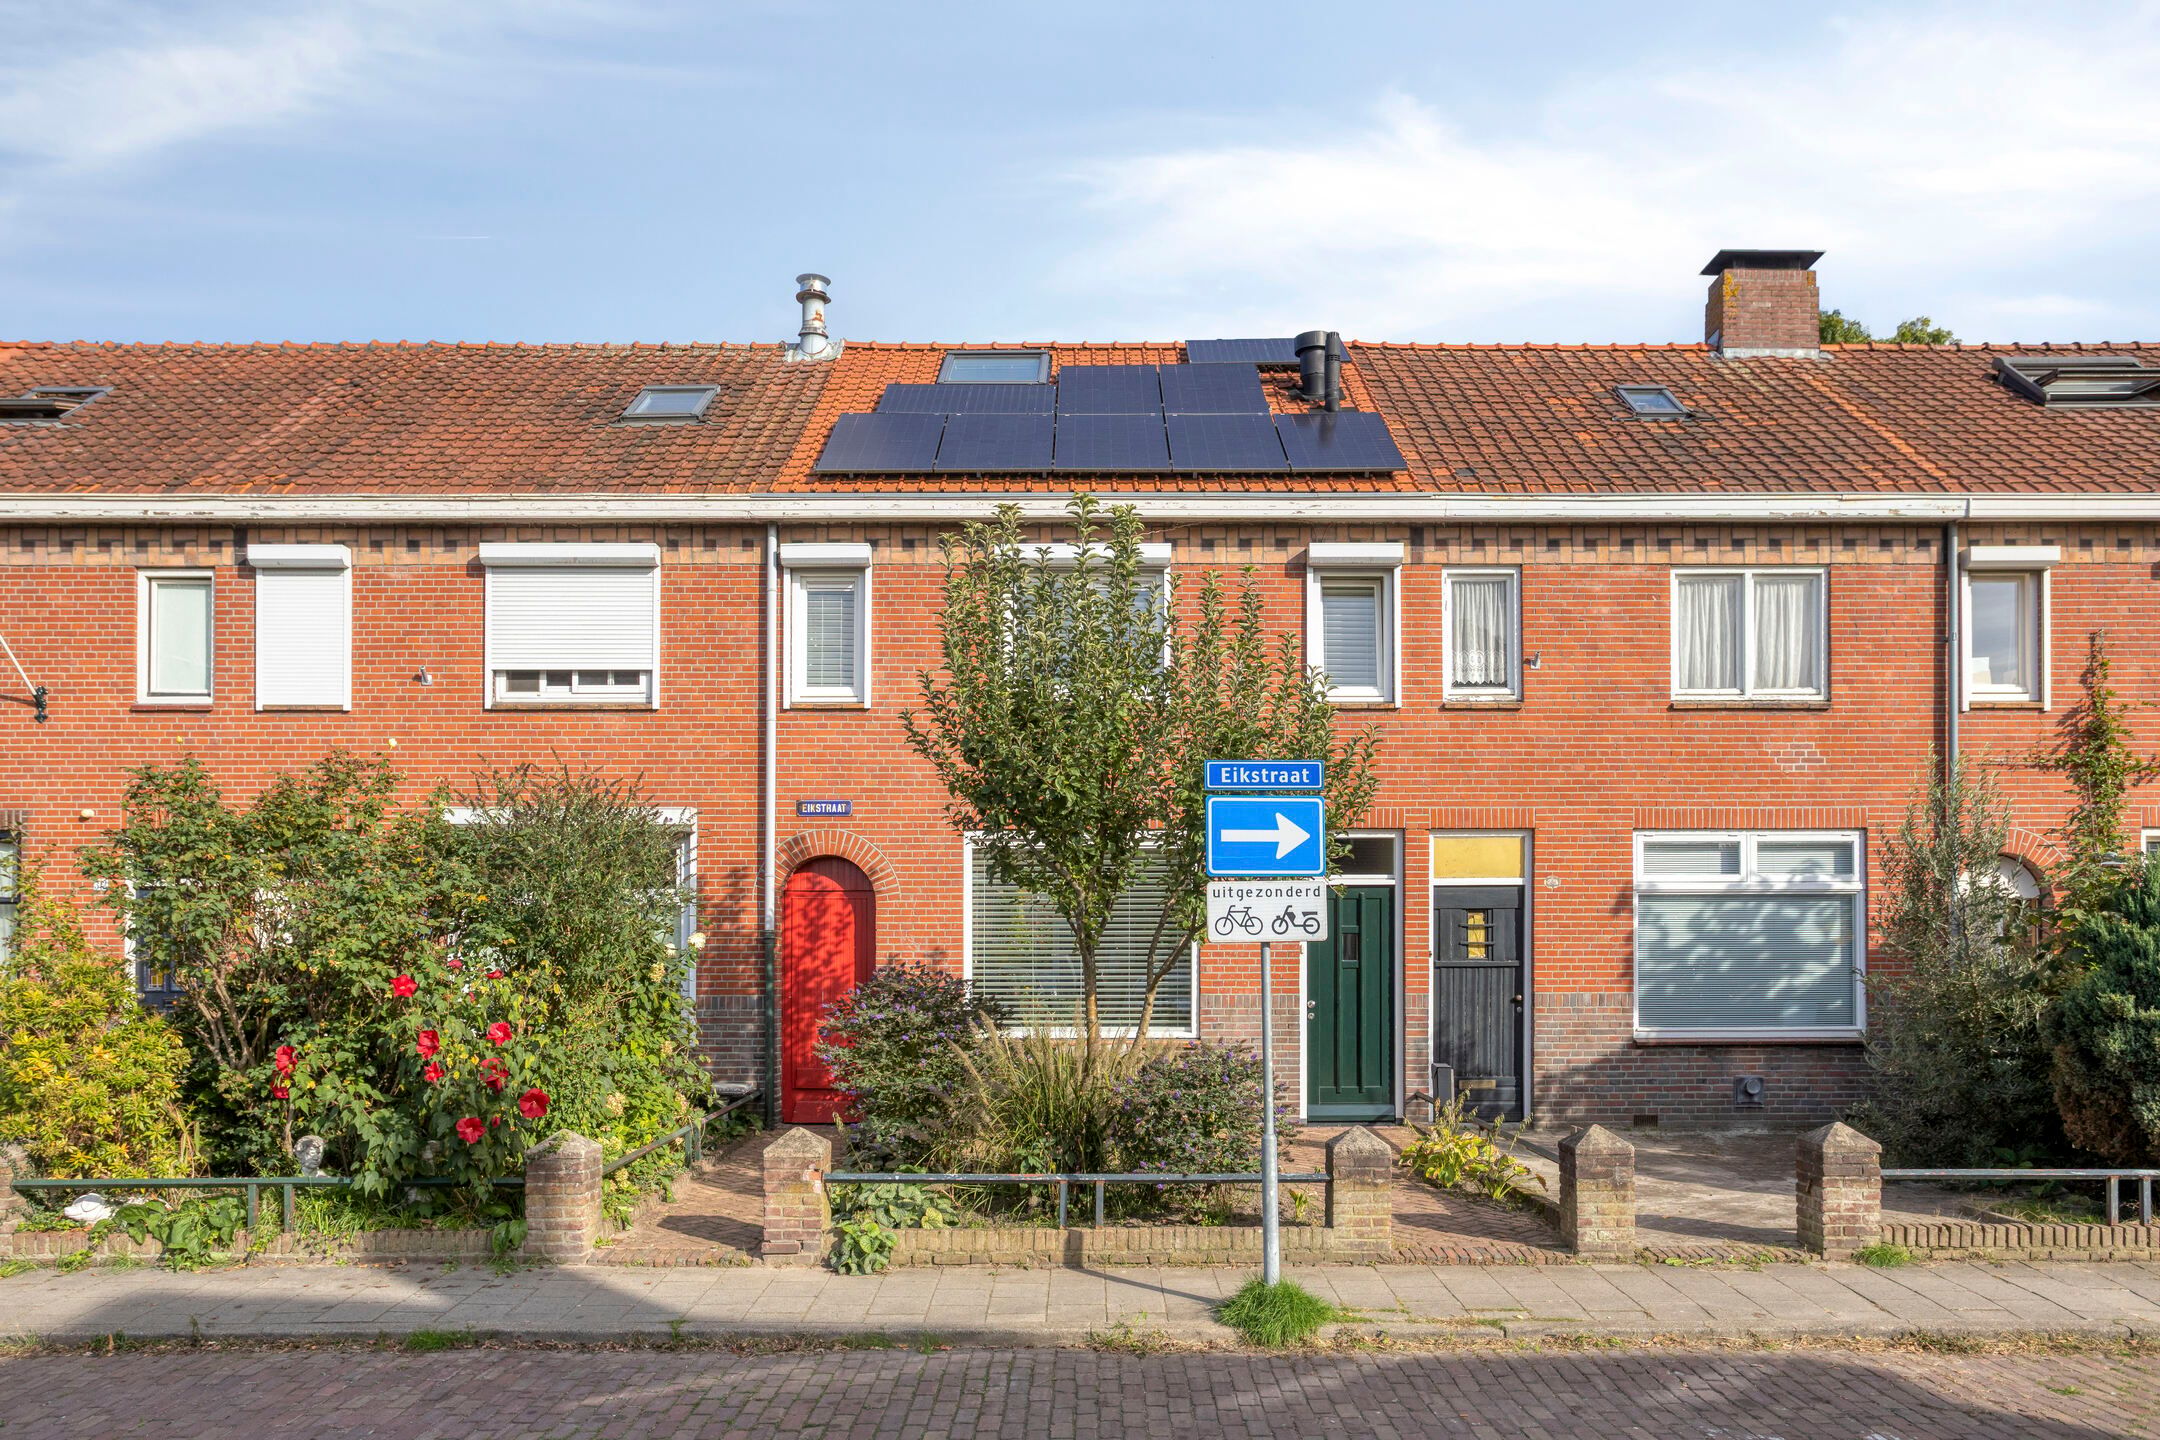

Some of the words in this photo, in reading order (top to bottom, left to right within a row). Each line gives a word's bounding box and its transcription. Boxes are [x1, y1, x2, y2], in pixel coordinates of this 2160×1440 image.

[1221, 767, 1310, 783] Eikstraat
[802, 803, 847, 813] EIKSTRAAT
[1212, 886, 1321, 901] uitgezonderd
